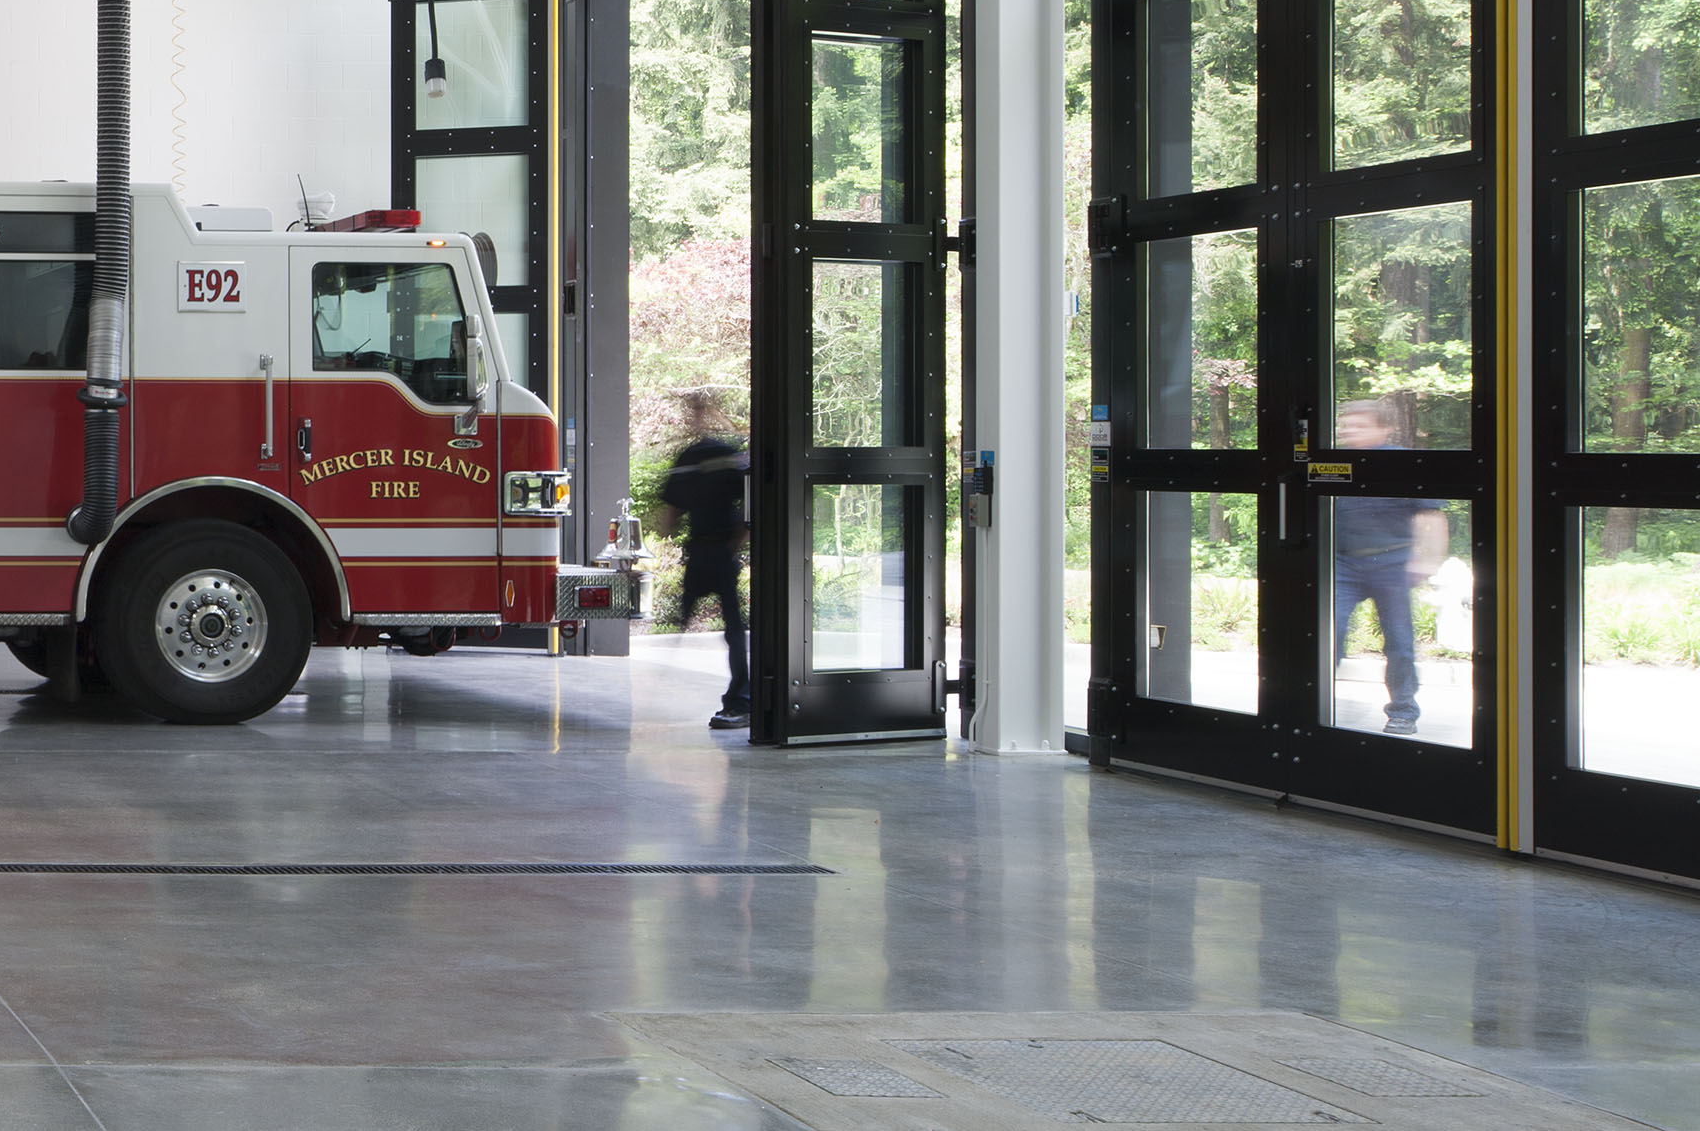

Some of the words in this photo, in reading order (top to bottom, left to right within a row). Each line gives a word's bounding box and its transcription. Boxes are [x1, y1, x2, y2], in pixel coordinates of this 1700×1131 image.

[186, 269, 240, 303] E92
[299, 448, 395, 486] MERCER
[403, 448, 491, 485] ISLAND
[1319, 465, 1349, 473] CAUTION
[369, 481, 421, 498] FIRE
